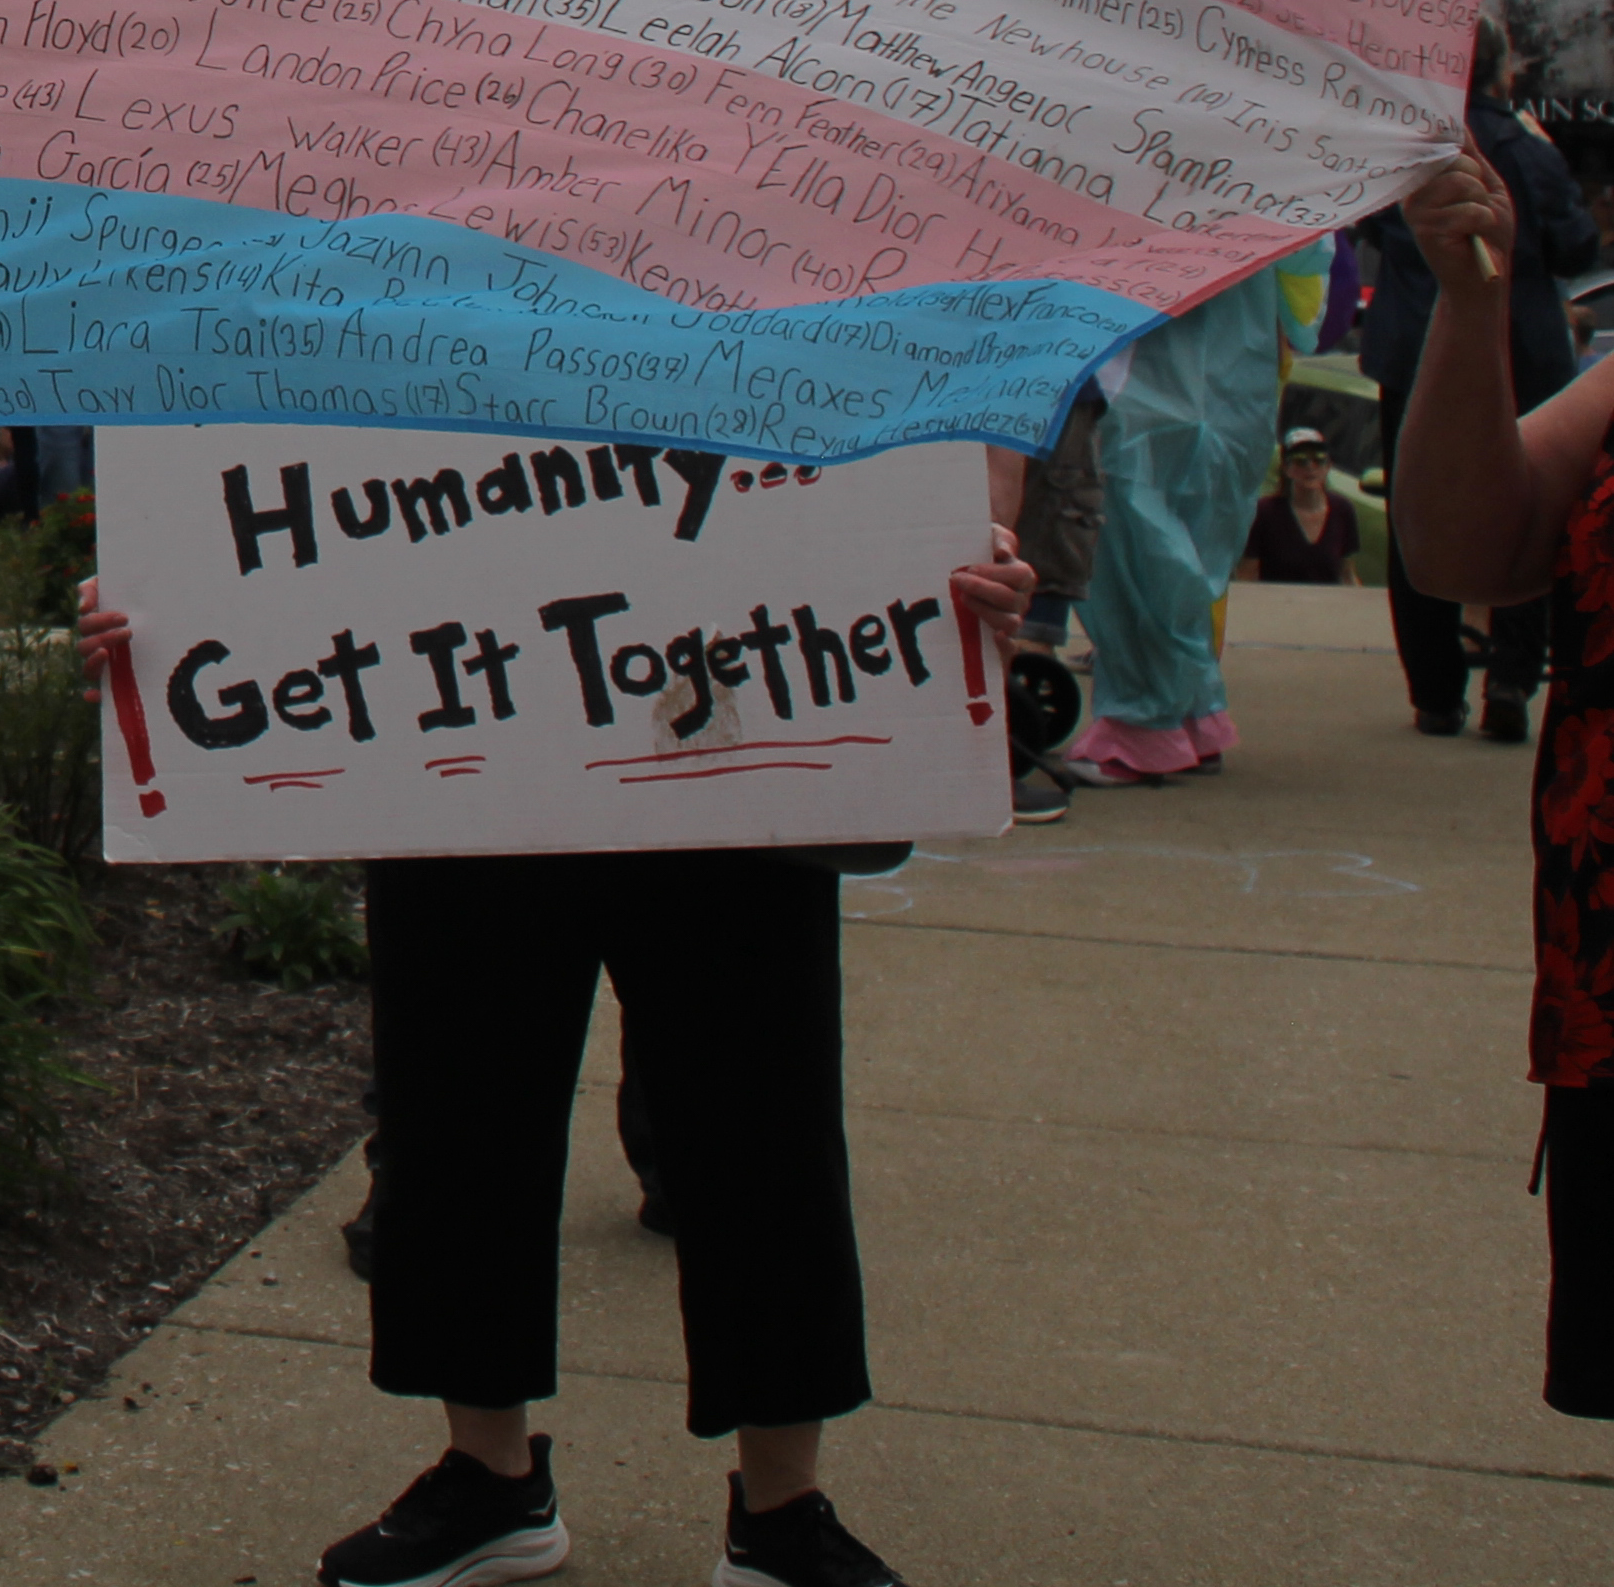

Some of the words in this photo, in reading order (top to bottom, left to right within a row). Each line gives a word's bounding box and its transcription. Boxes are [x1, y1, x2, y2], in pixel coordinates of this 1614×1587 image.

[704, 68, 783, 126] Fern
[338, 308, 488, 366] Andrea
[168, 628, 379, 750] Get
[409, 620, 519, 733] It
